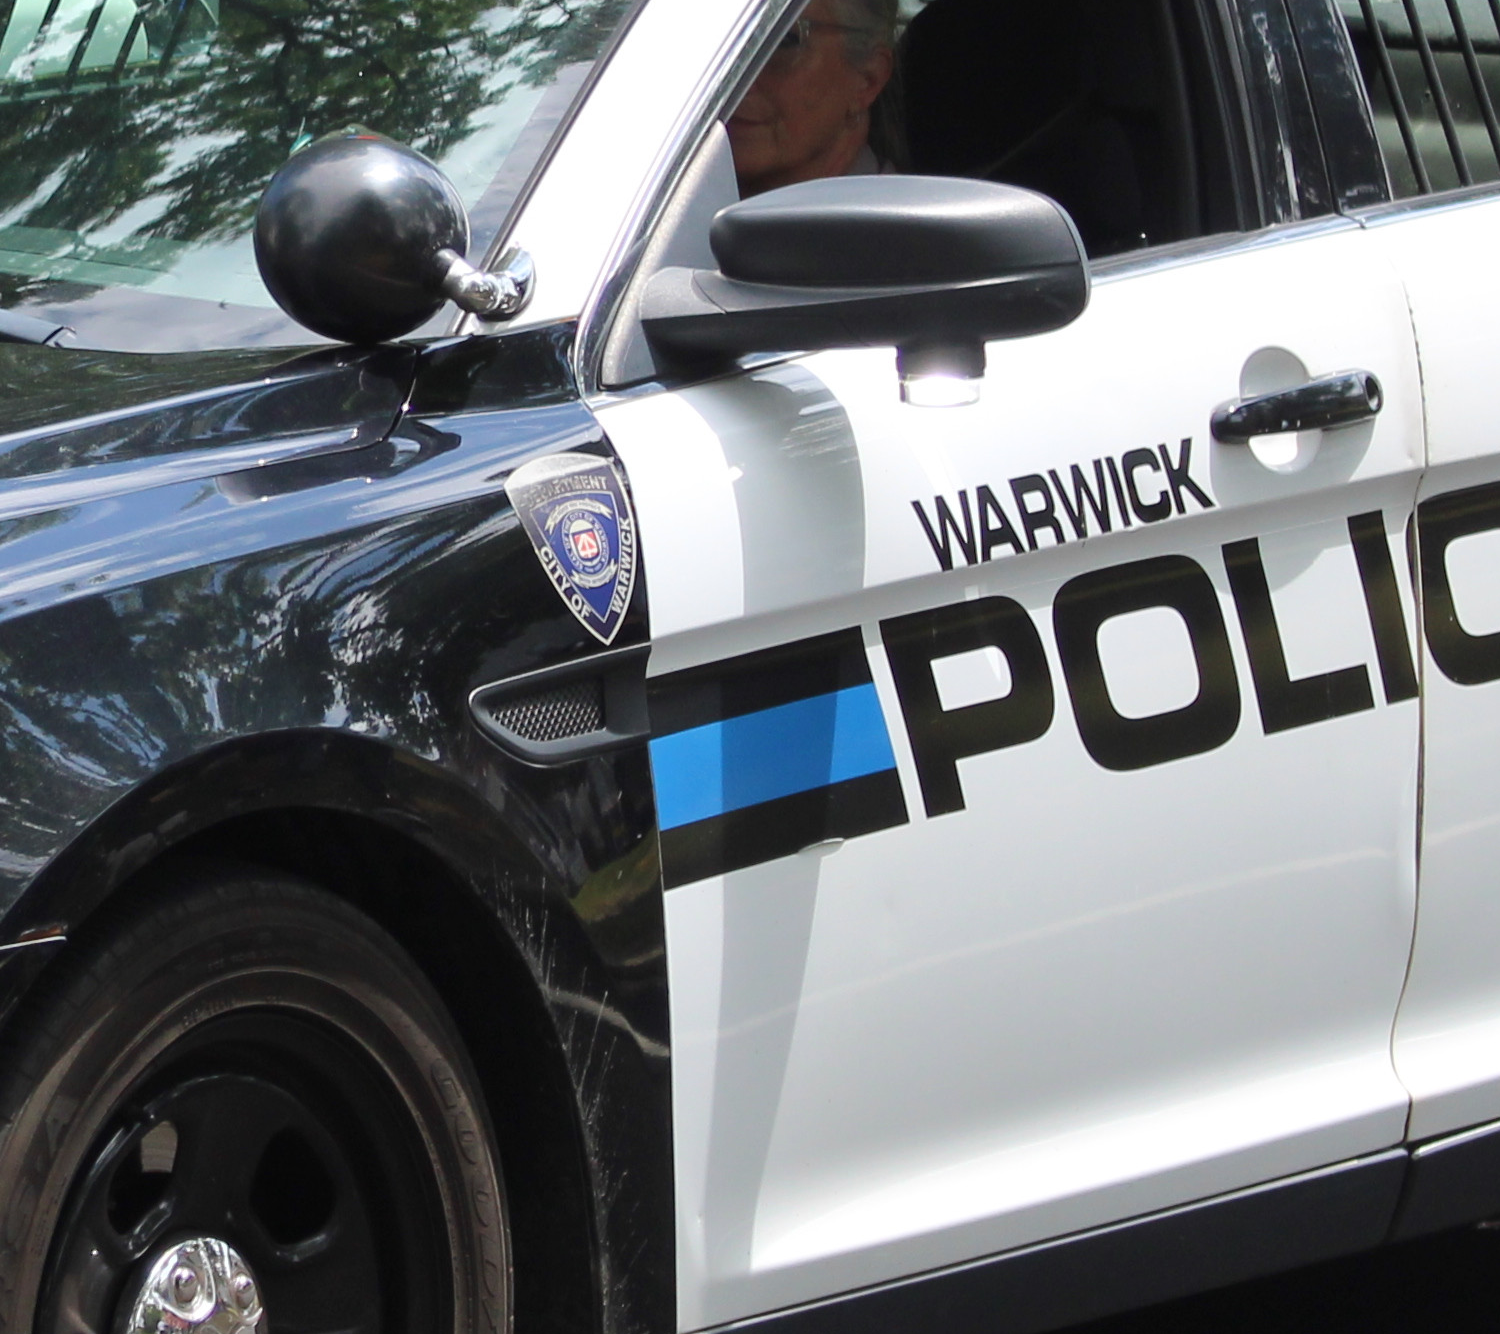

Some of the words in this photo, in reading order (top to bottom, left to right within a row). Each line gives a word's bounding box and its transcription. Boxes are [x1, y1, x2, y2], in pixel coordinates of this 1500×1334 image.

[519, 475, 609, 509] DEPARTMENT
[913, 436, 1215, 572] WARWICK
[541, 546, 572, 590] CITY
[571, 595, 592, 619] OF
[610, 517, 632, 614] WARWICK
